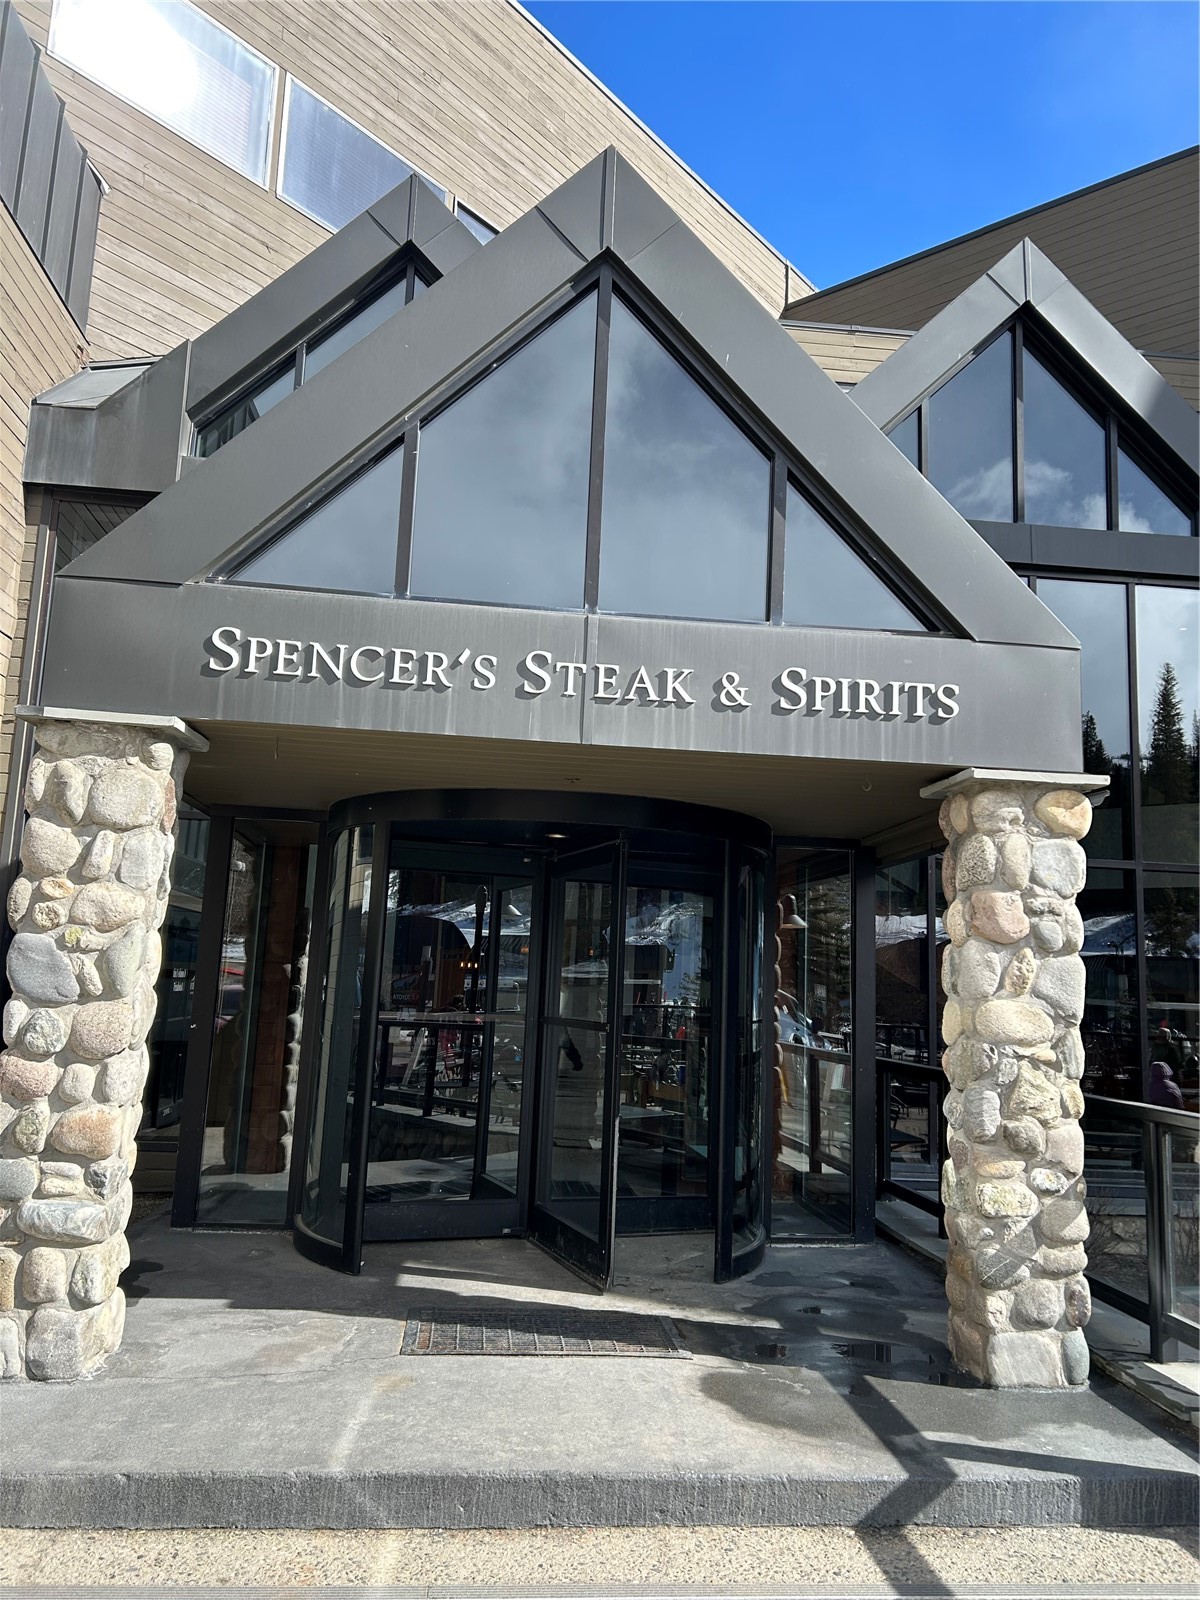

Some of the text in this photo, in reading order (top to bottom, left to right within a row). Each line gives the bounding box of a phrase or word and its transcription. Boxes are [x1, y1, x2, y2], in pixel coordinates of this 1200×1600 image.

[208, 626, 961, 719] SPENCER'S STEAK & SPIRITS
